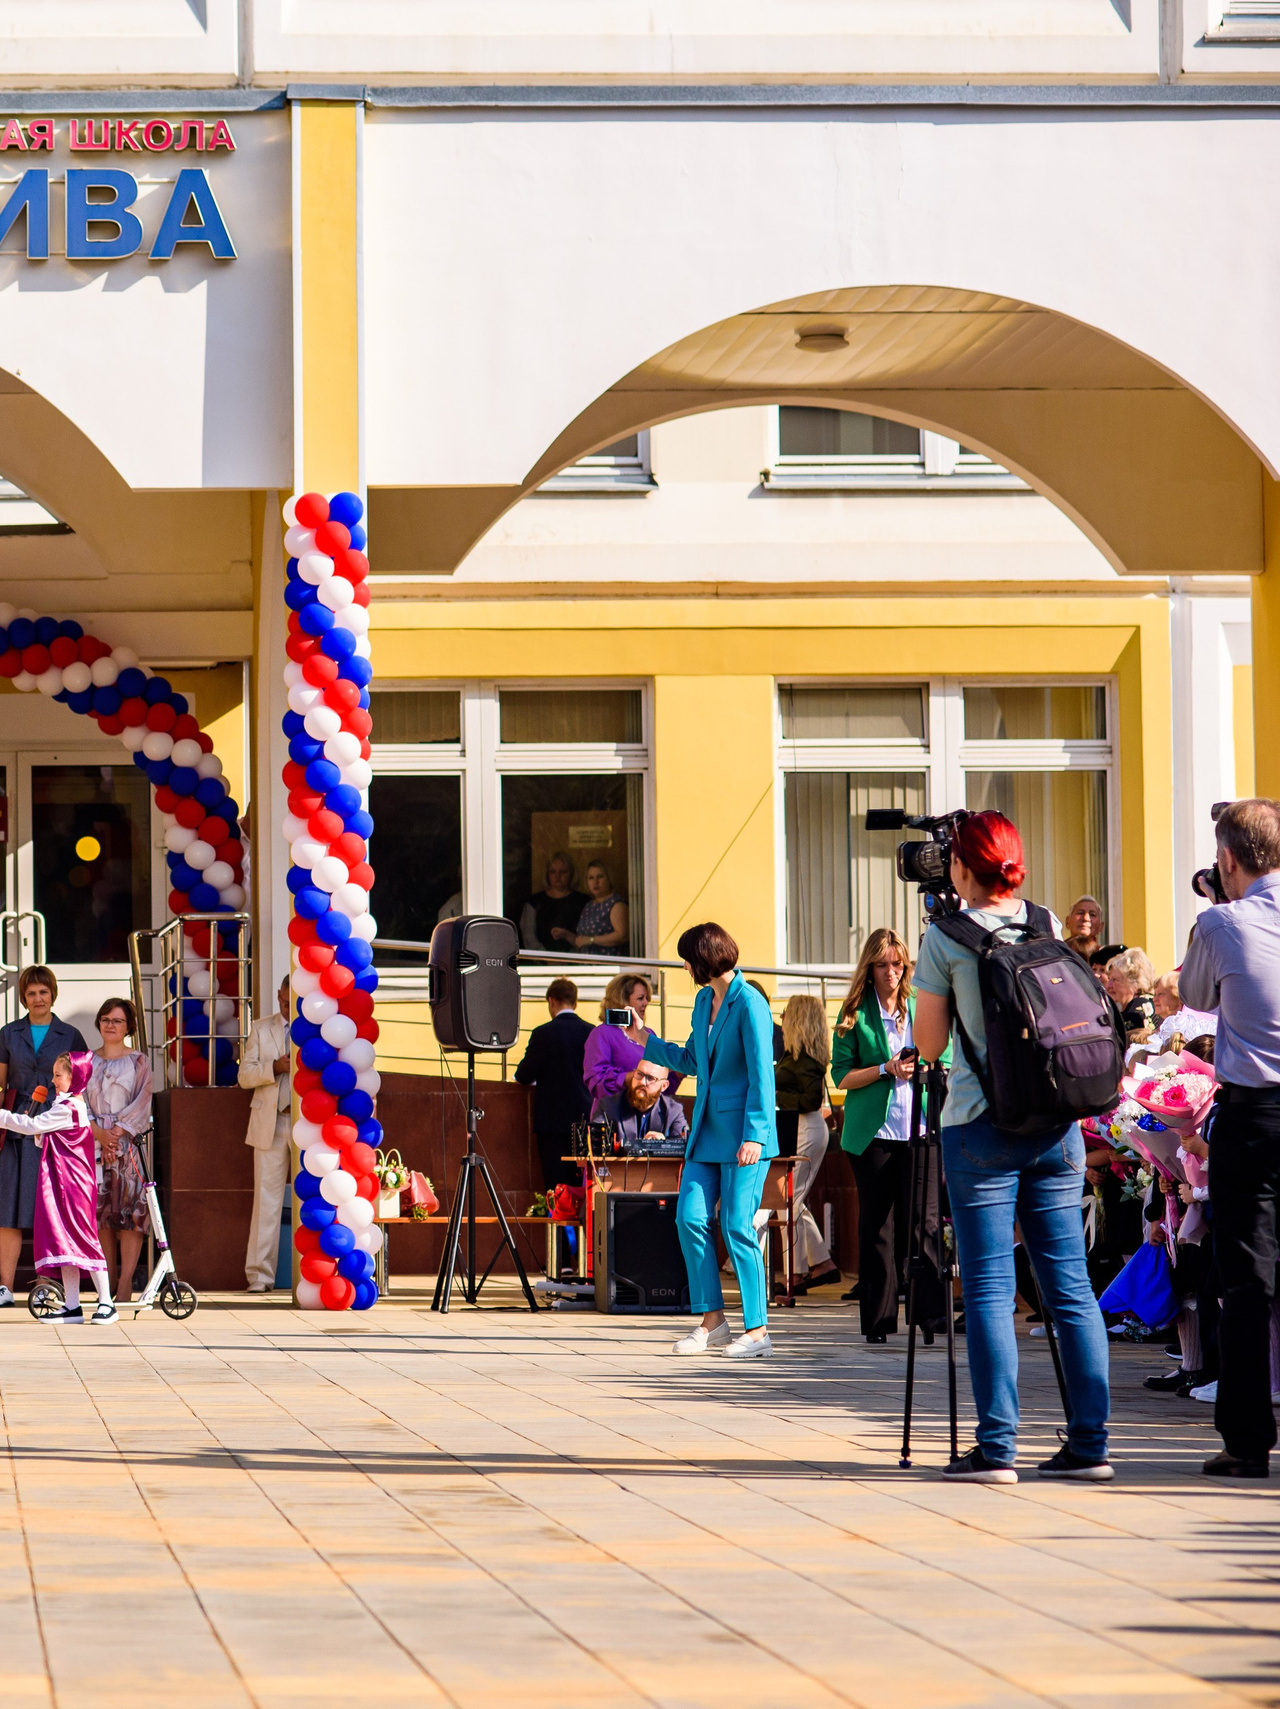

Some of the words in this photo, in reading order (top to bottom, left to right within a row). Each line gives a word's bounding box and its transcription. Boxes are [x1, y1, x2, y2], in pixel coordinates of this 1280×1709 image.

[69, 118, 238, 152] ШКОЛА
[485, 958, 503, 966] EON
[651, 1288, 676, 1296] EON
